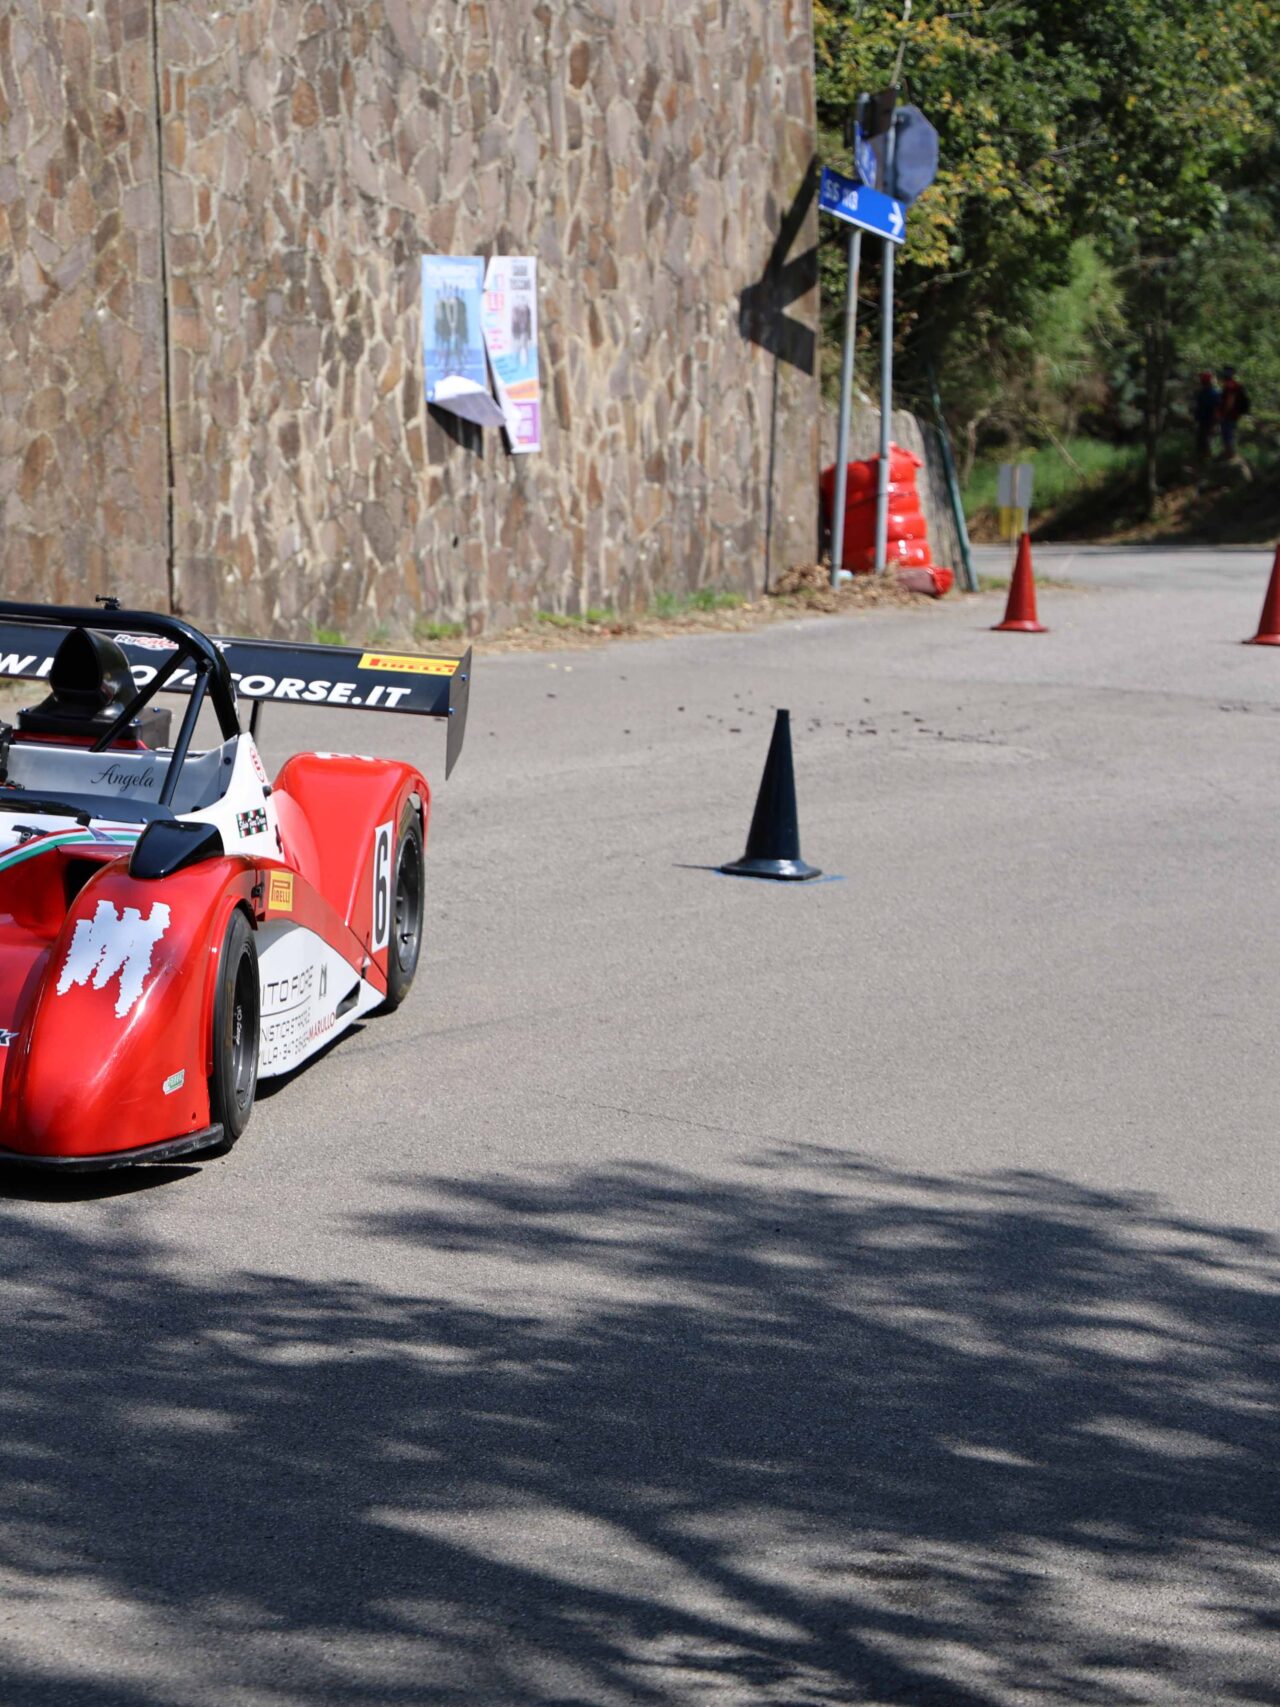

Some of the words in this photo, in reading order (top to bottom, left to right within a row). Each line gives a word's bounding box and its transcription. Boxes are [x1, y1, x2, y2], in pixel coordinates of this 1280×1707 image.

[90, 763, 154, 792] Angela
[271, 879, 291, 903] PIRELLI
[375, 829, 388, 945] 6
